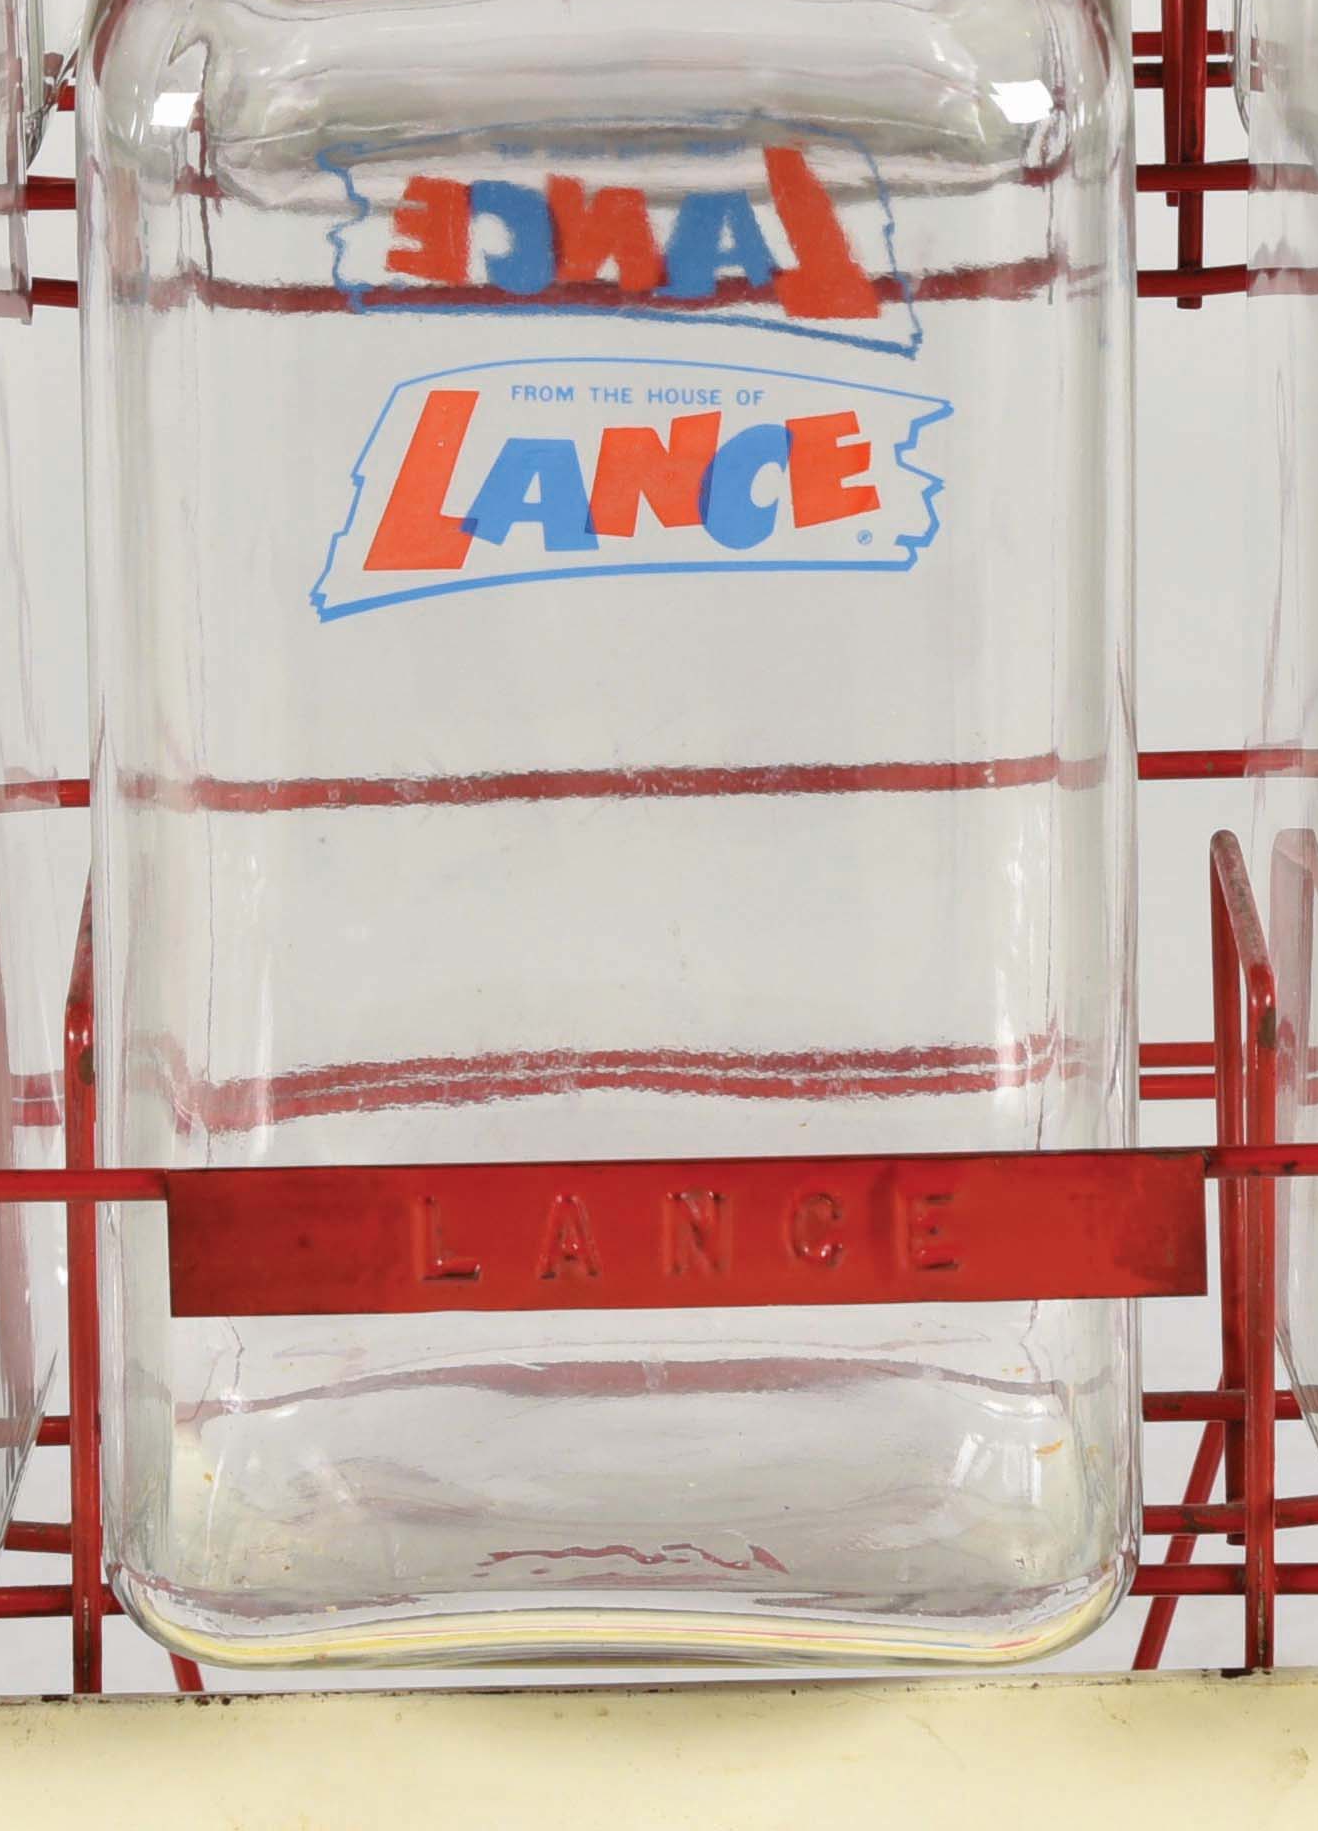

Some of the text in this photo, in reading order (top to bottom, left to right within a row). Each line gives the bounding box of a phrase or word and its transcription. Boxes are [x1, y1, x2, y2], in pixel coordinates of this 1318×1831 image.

[510, 384, 765, 407] FROM THE HOUSE OF
[362, 389, 881, 571] LANCE
[415, 1192, 962, 1282] LANCE
